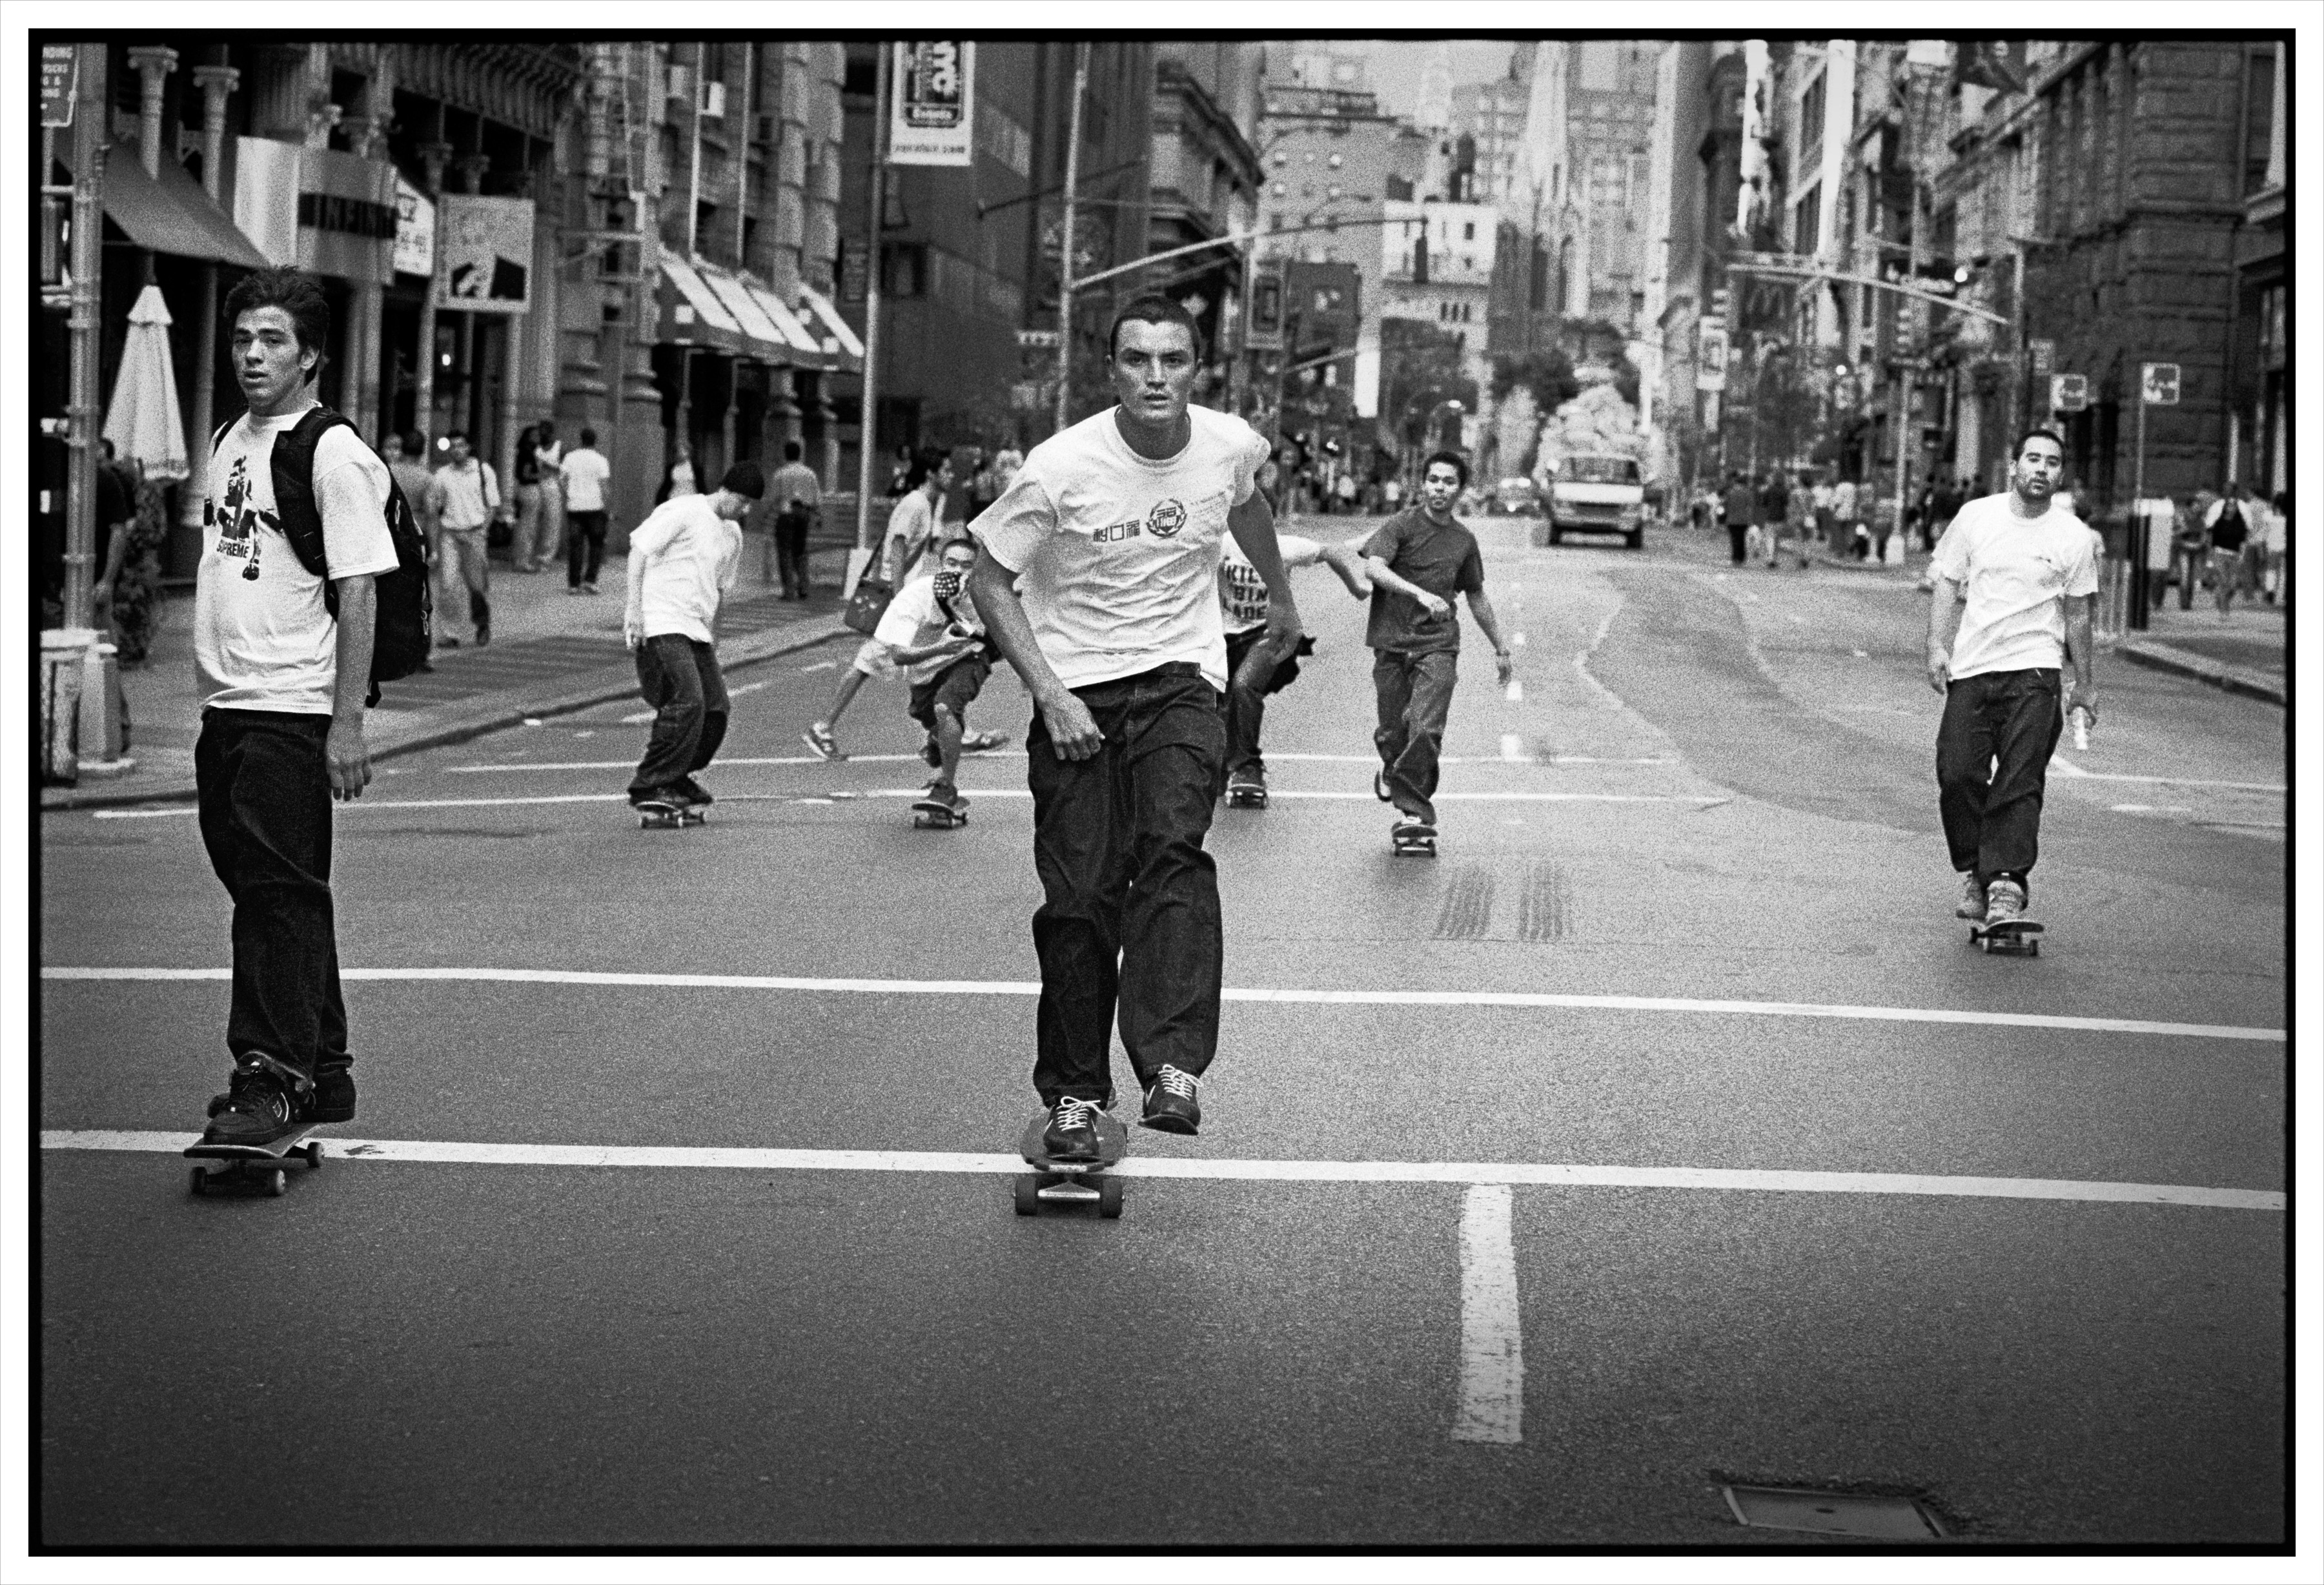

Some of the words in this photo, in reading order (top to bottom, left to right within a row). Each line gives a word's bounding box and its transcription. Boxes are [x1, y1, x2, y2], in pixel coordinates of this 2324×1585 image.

[1227, 564, 1259, 583] KIL
[1234, 586, 1268, 601] BIN
[1223, 598, 1267, 620] LADE
